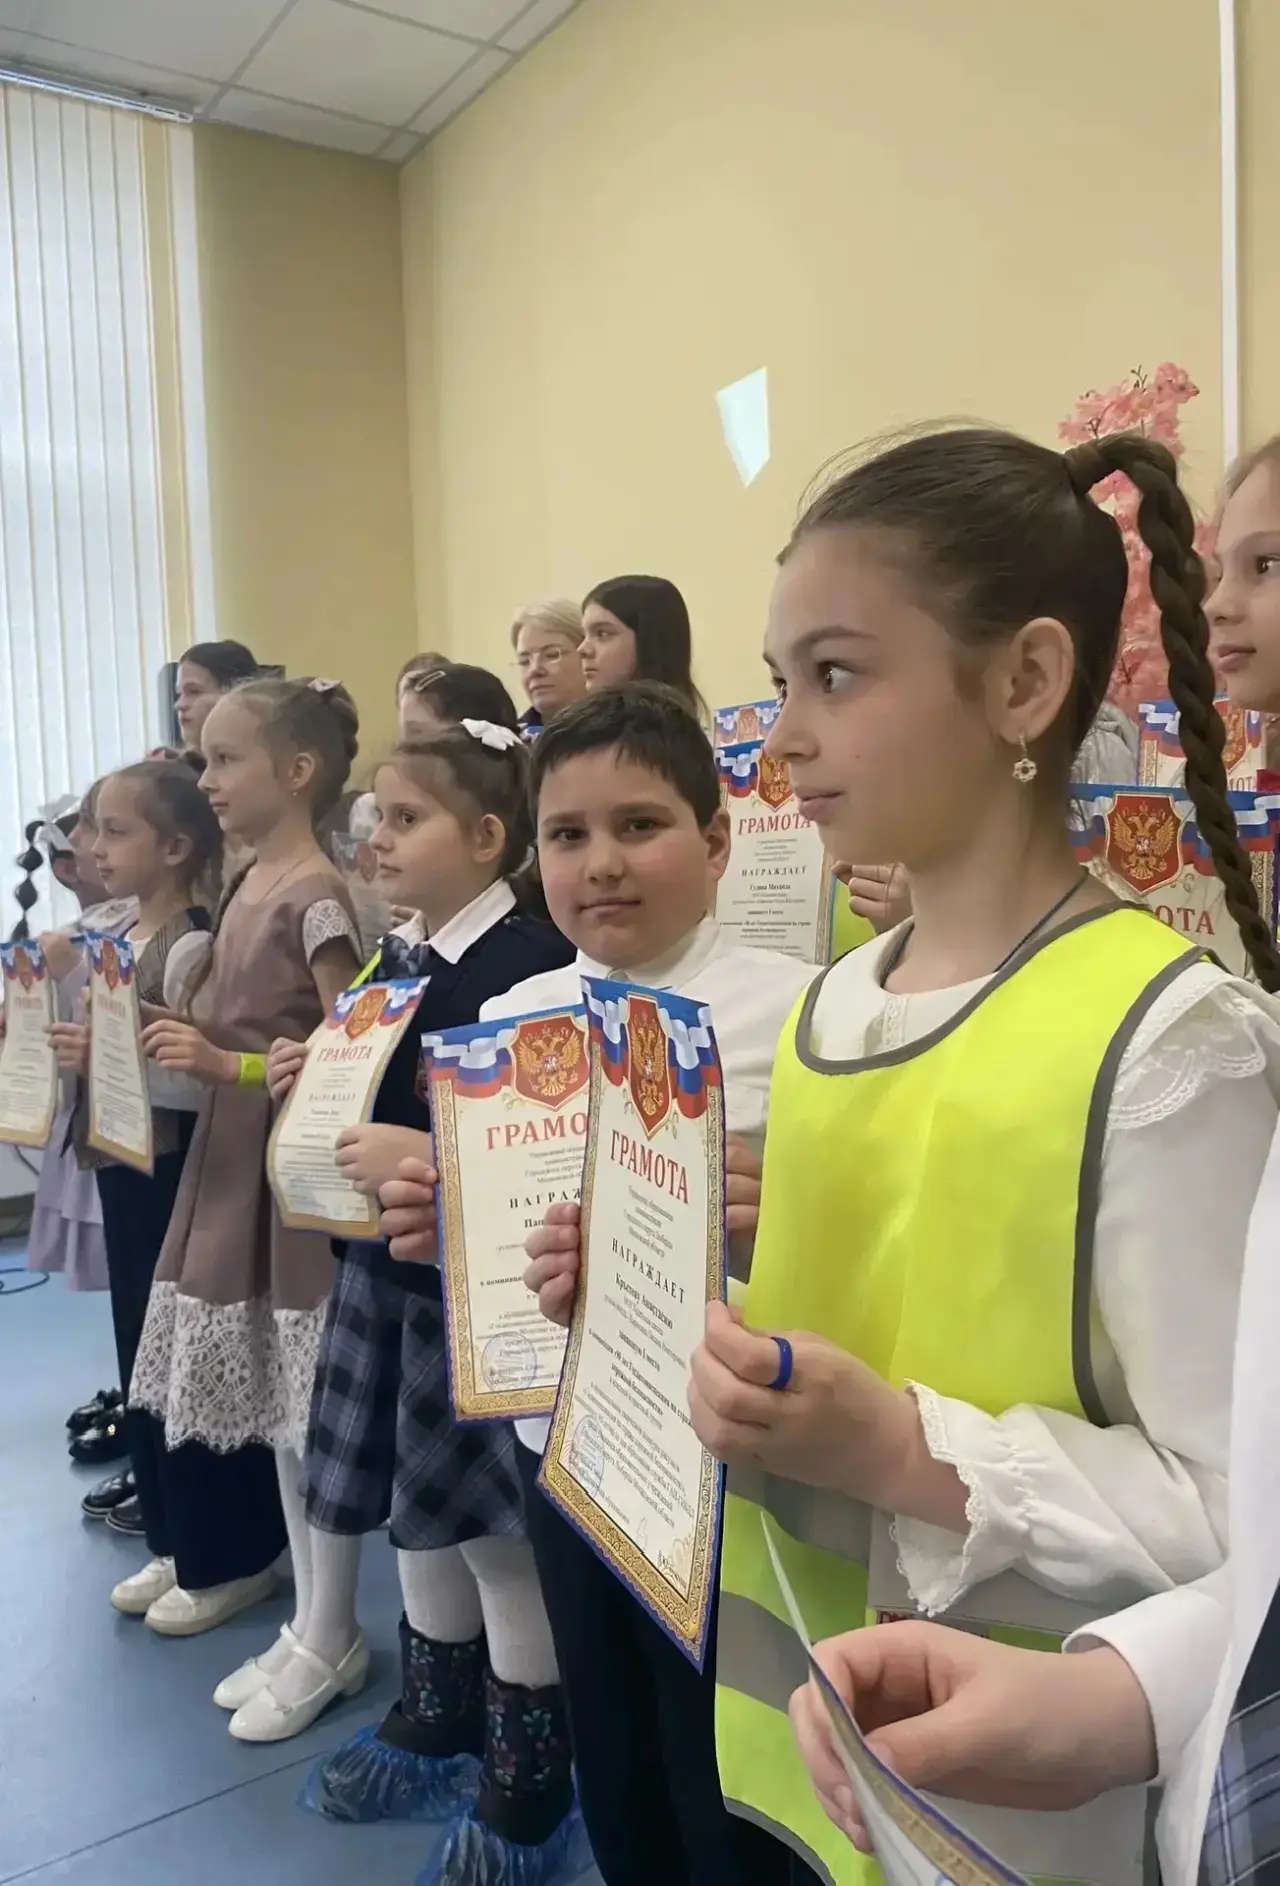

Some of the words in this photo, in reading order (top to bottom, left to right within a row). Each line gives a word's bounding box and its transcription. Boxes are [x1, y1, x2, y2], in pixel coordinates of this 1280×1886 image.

[738, 813, 812, 836] ГРАМОТА
[741, 865, 808, 877] НАГРАЖДАЕТ
[317, 1045, 373, 1063] ГРАМОТА
[610, 1128, 689, 1205] ГРАМОТА
[612, 1237, 686, 1304] НАГРАЖДАЕТ
